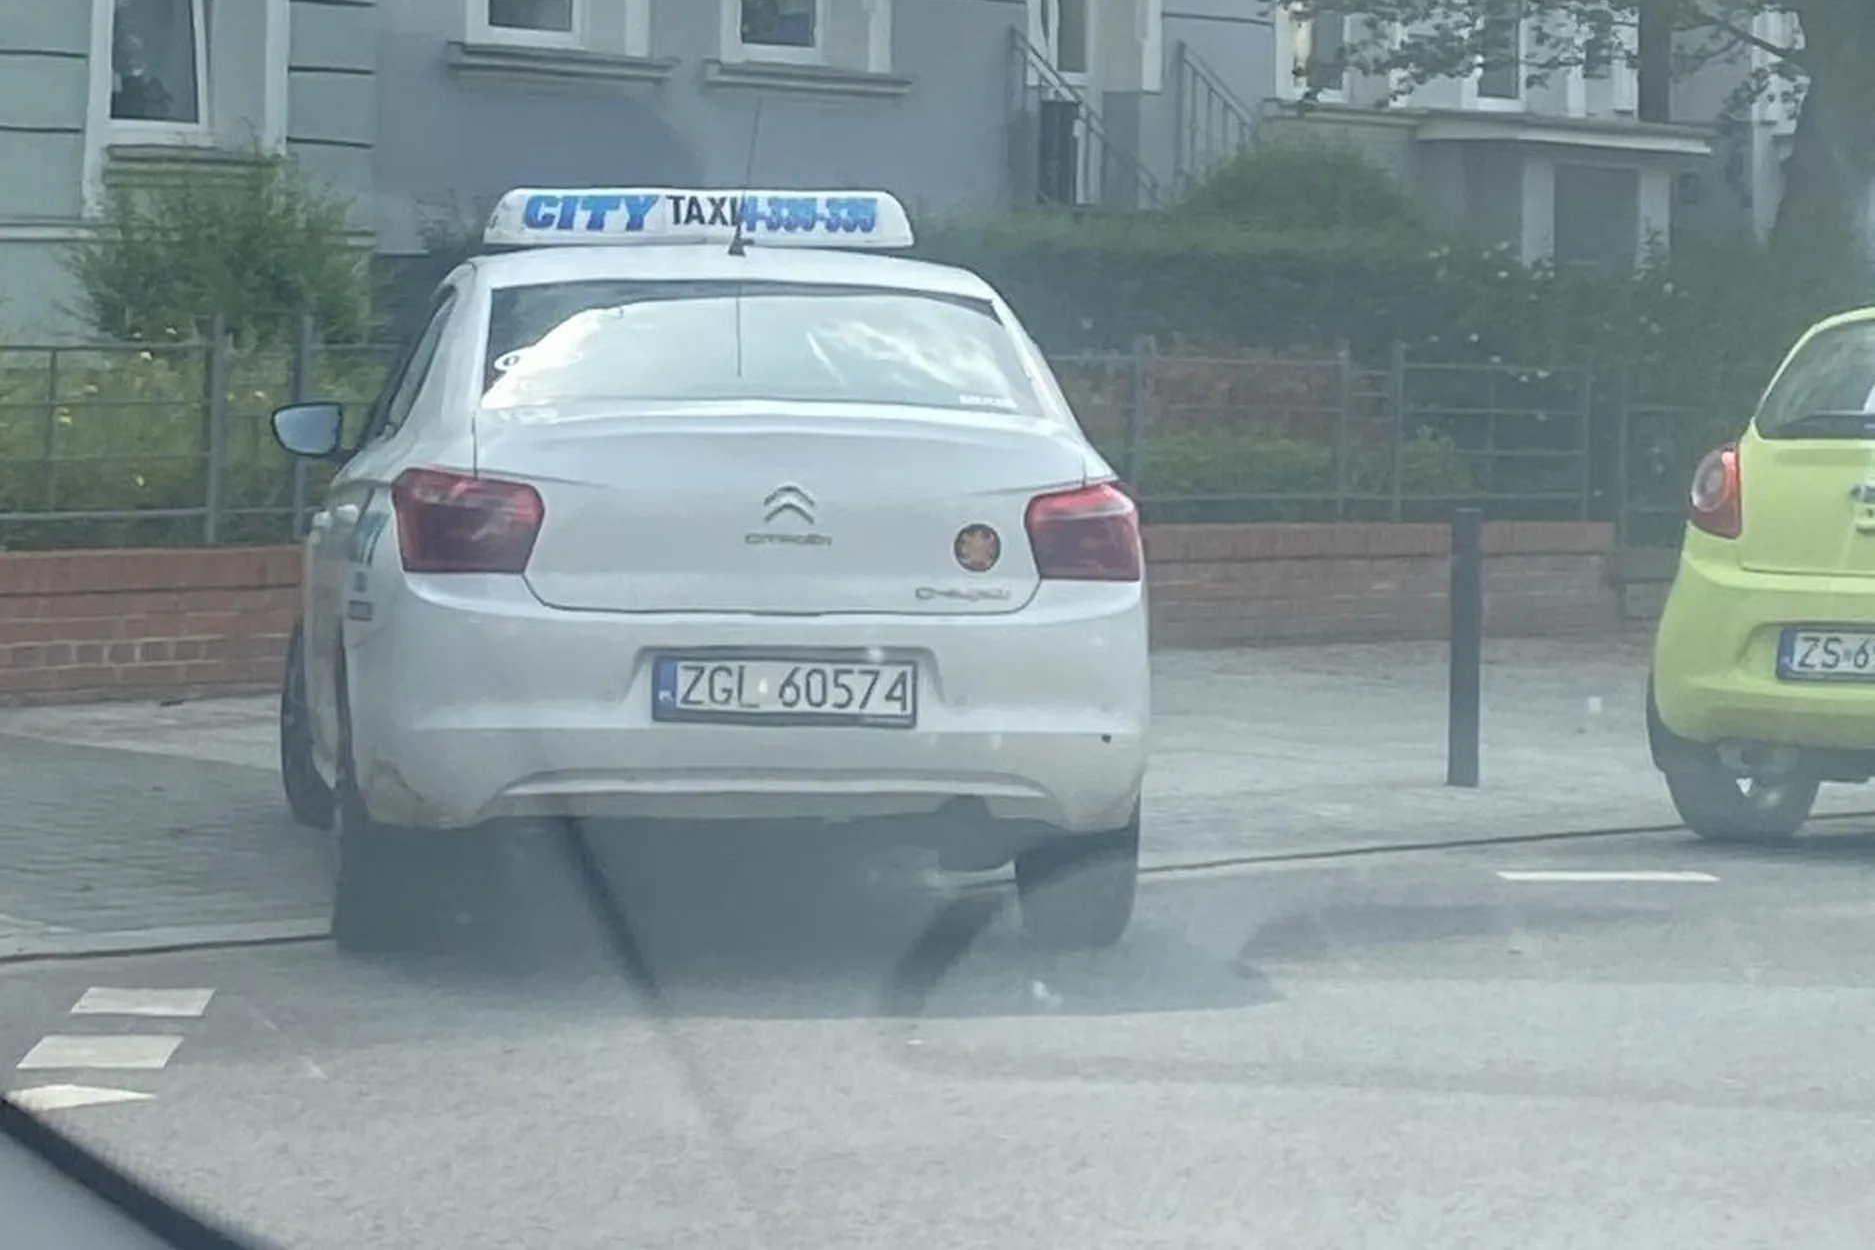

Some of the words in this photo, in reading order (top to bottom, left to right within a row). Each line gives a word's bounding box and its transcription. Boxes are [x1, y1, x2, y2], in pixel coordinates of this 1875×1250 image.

[522, 194, 659, 231] CITY
[666, 195, 738, 227] TAXI
[1797, 636, 1843, 669] ZS
[1854, 637, 1875, 669] 6
[680, 664, 760, 708] ZGL
[777, 666, 909, 712] 60574
